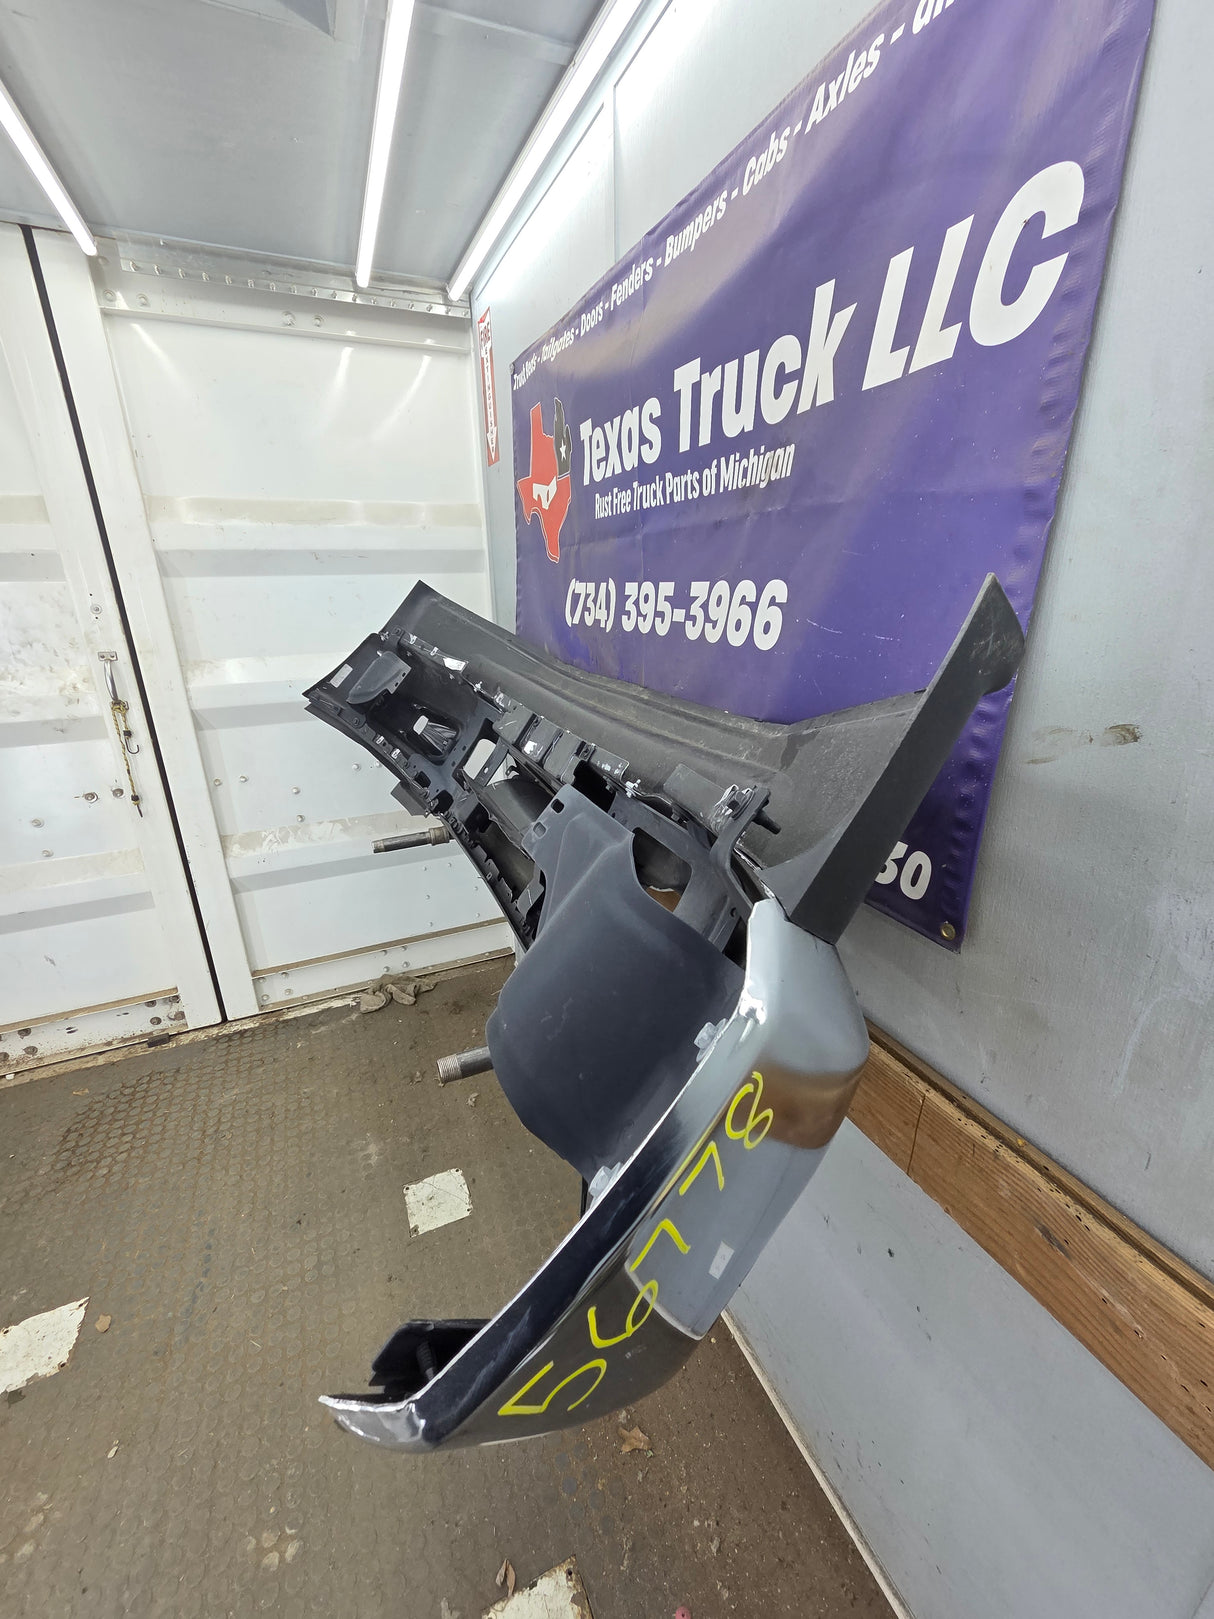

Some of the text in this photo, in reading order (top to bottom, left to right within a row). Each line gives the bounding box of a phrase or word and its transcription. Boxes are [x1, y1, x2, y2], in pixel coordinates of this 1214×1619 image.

[541, 327, 575, 364] Tailgates
[580, 301, 604, 337] Doors
[610, 257, 654, 311] Fenders
[664, 189, 728, 268] Bumpers
[742, 126, 791, 196] Cabs
[804, 33, 885, 135] Axles
[580, 161, 1085, 487] Texas Truck LLC
[565, 577, 788, 651] (734) 395-3966
[595, 444, 796, 520] Rust Free Truck Parts of Michigan
[498, 1071, 773, 1416] 56778
